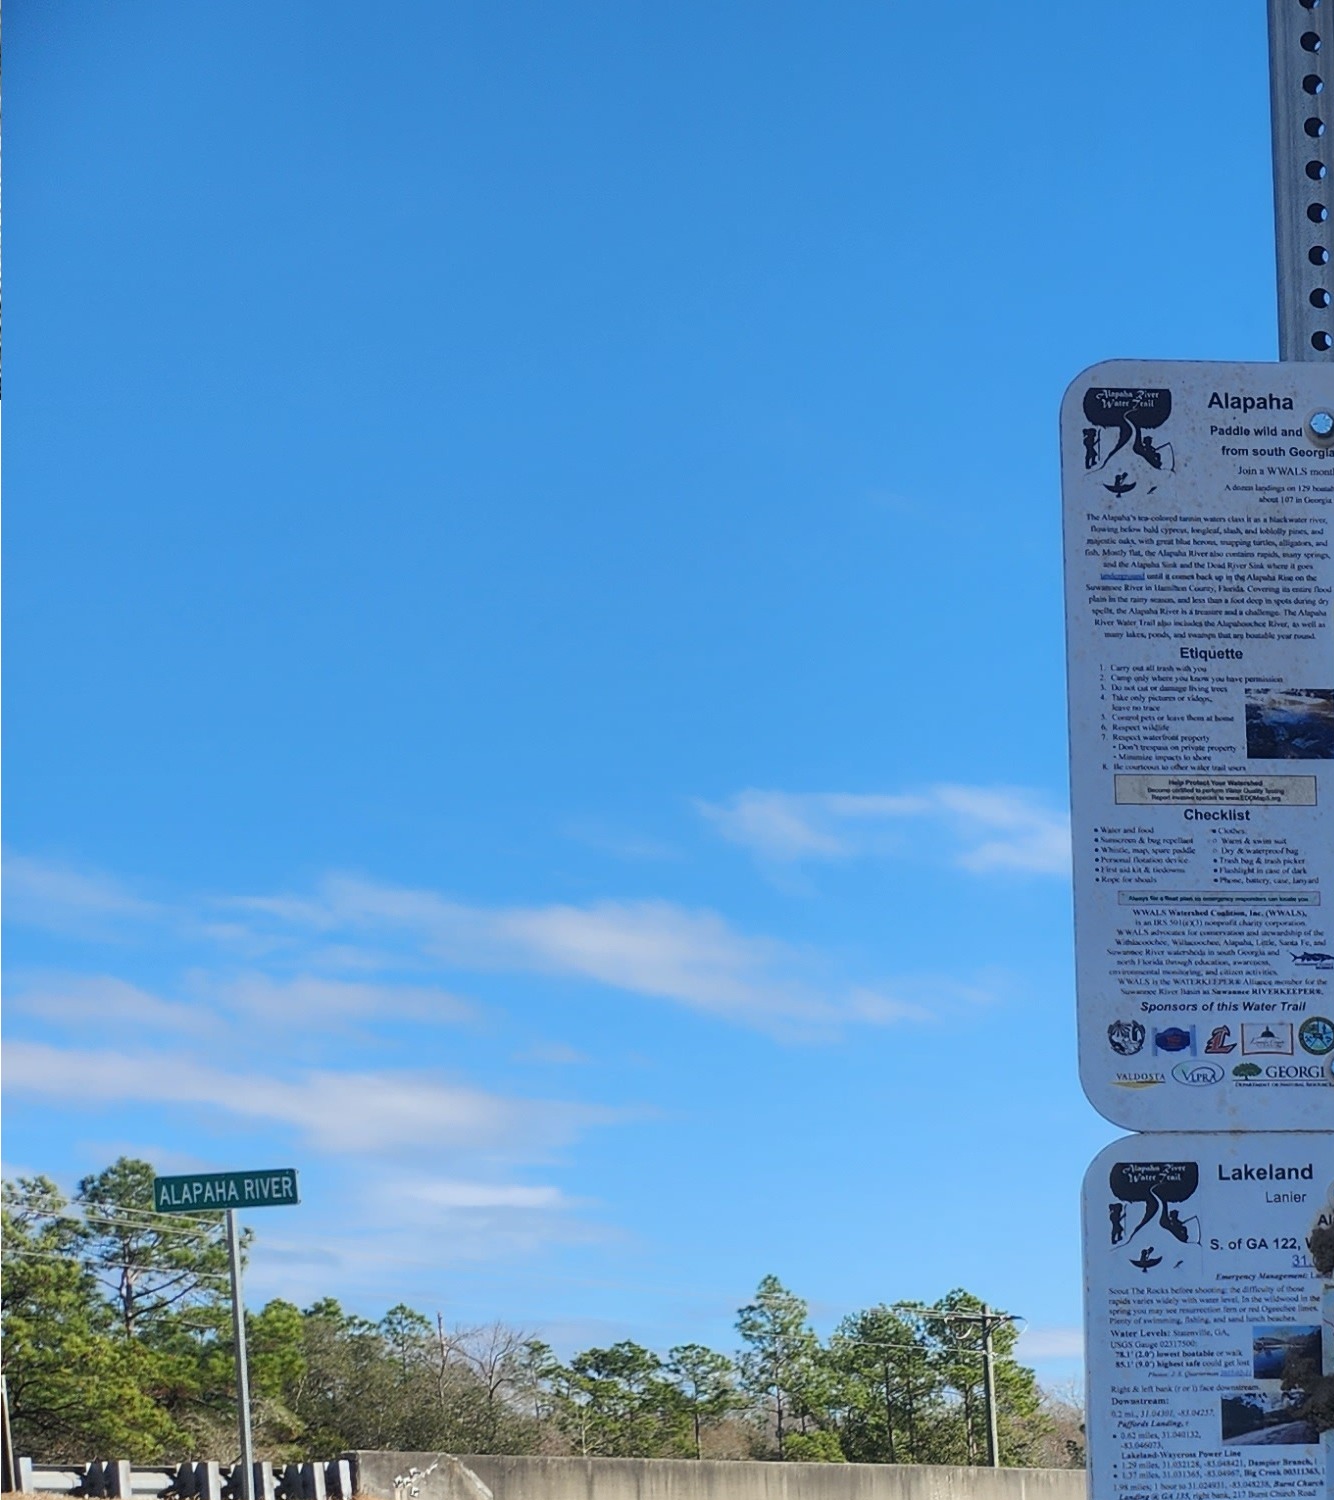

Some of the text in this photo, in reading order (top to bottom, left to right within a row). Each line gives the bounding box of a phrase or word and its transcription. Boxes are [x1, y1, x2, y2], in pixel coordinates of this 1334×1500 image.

[1096, 390, 1159, 400] Alapaha River
[1208, 392, 1293, 414] Alapaha
[1210, 426, 1251, 436] Paddle
[1253, 426, 1278, 436] wild
[1280, 427, 1302, 437] and
[1222, 446, 1249, 456] from
[1252, 446, 1286, 456] south
[1288, 447, 1334, 459] Georgia
[1238, 467, 1257, 475] Join
[1267, 467, 1308, 476] WWALS
[1180, 647, 1244, 662] Etiquette
[1184, 808, 1250, 820] Checklist
[1210, 909, 1247, 918] Coalition,
[1265, 910, 1307, 919] (WWALS),
[1140, 1001, 1306, 1014] Sponsors of this Water Trail
[1266, 1066, 1325, 1078] GEORGI
[1122, 1164, 1186, 1174] Alapaha River
[1218, 1162, 1313, 1180] Lakeland
[159, 1176, 293, 1206] ALAPAHA RIVER
[1266, 1191, 1306, 1203] Lanier
[1210, 1238, 1225, 1250] S.
[1228, 1238, 1243, 1250] of
[1246, 1238, 1268, 1249] GA
[1271, 1238, 1300, 1251] 122,
[1215, 1273, 1256, 1282] Emergency
[1257, 1272, 1308, 1281] Management:
[1110, 1329, 1138, 1337] Water
[1140, 1329, 1171, 1337] Levels:
[1111, 1397, 1169, 1405] Downstream:
[1122, 1450, 1196, 1460] Lakeland-Waycross
